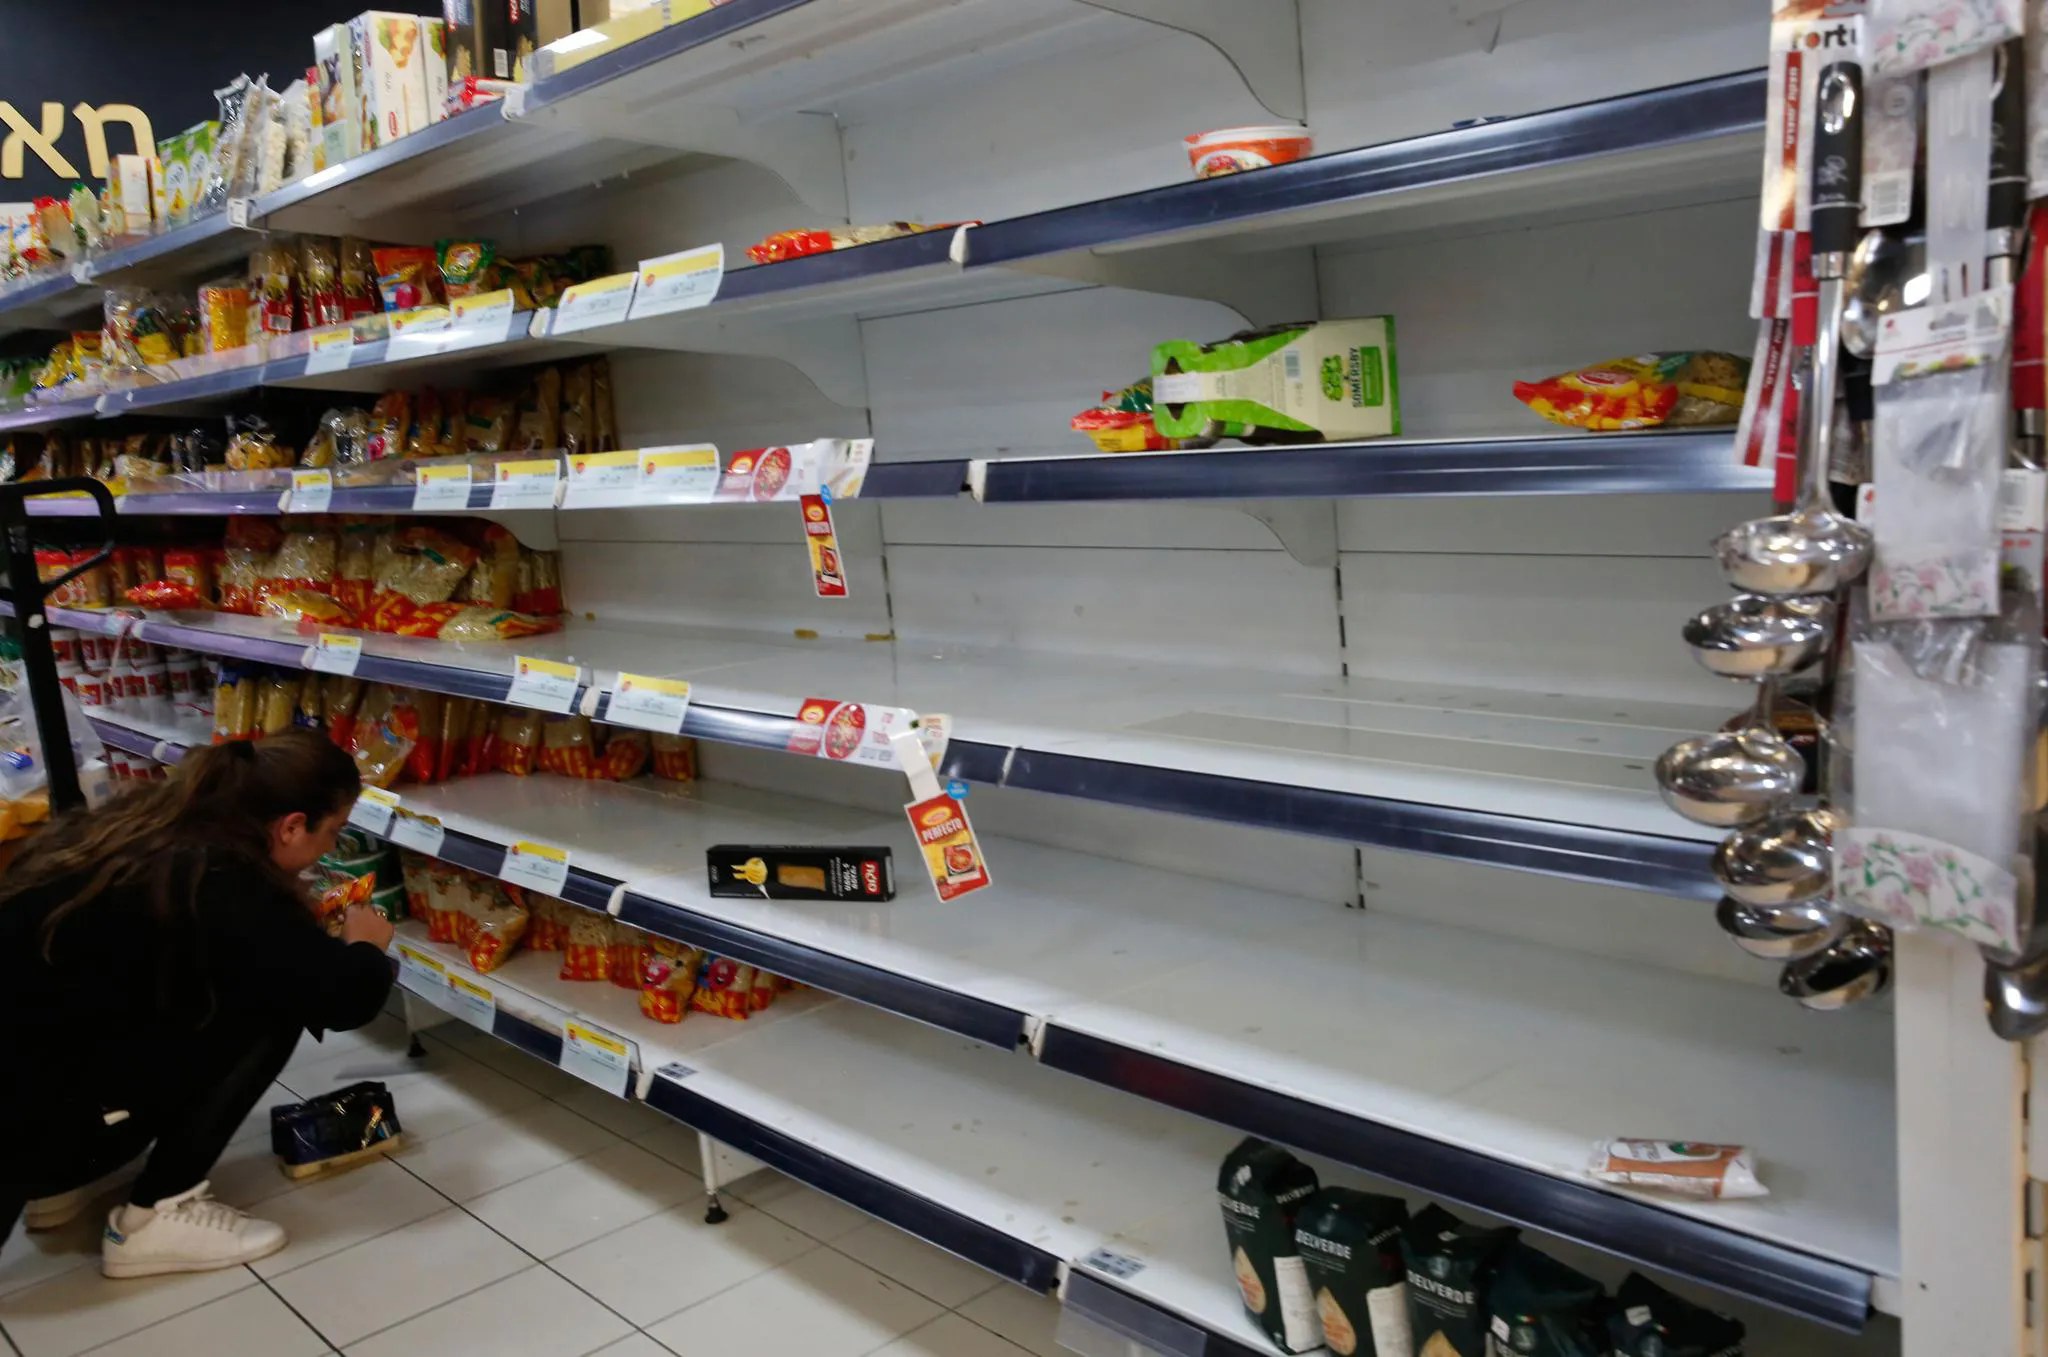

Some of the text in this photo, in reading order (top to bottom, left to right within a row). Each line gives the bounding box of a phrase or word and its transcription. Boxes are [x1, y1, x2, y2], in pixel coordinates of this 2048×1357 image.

[1351, 347, 1362, 408] SOMERSBY
[1295, 1229, 1351, 1259] DELVERDE
[1407, 1270, 1475, 1304] DELVERDE
